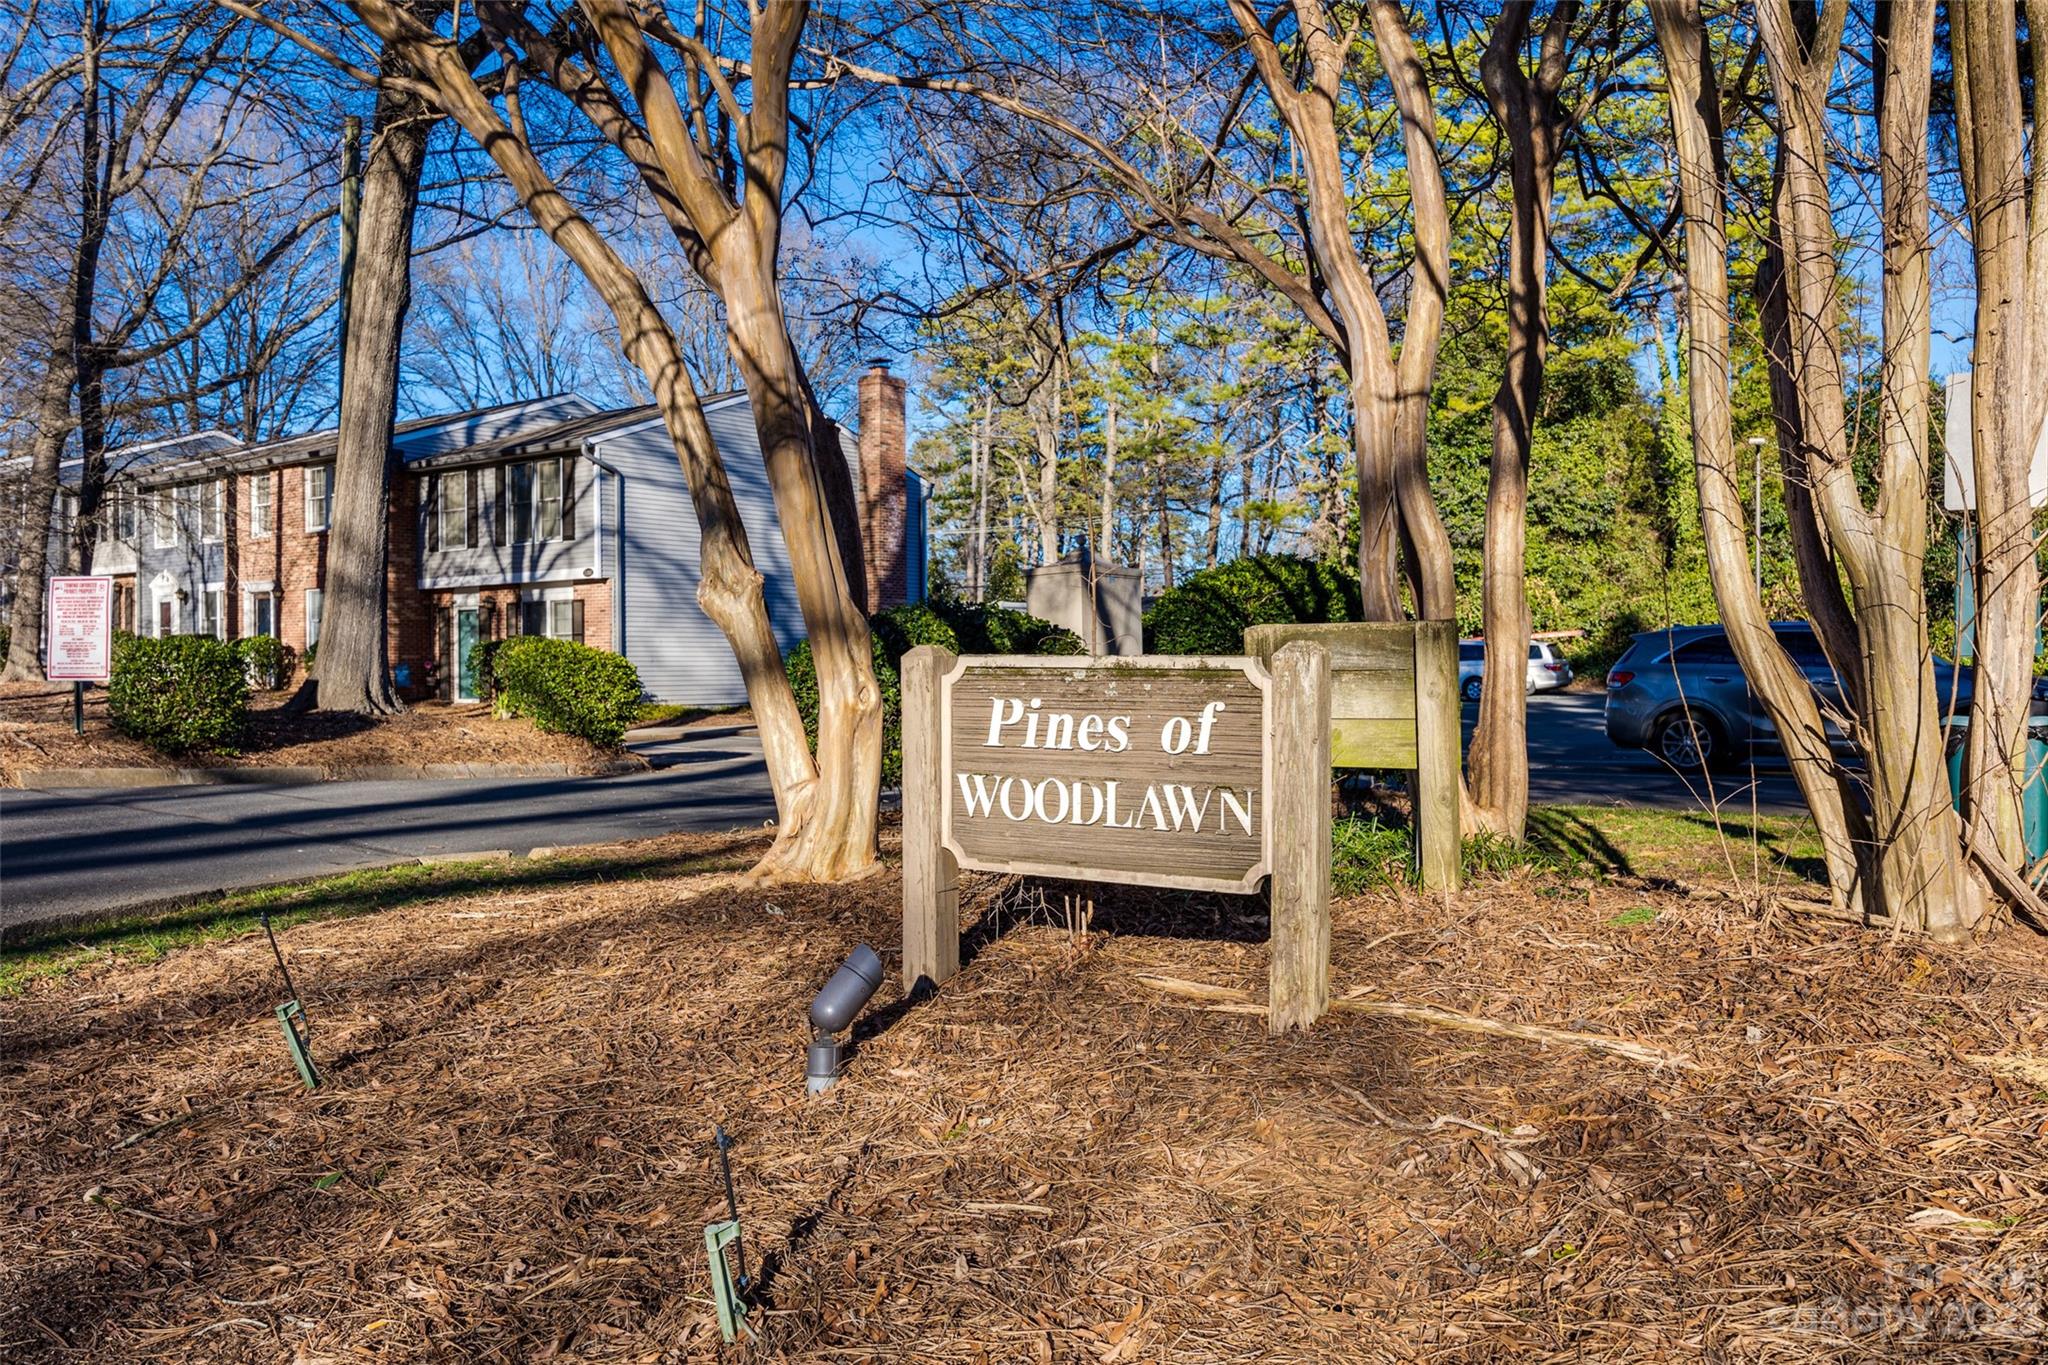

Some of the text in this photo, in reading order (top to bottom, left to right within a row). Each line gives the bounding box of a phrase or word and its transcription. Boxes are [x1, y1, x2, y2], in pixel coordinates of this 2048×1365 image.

[983, 697, 1226, 755] Pines of
[956, 773, 1257, 837] WOODLAWN
